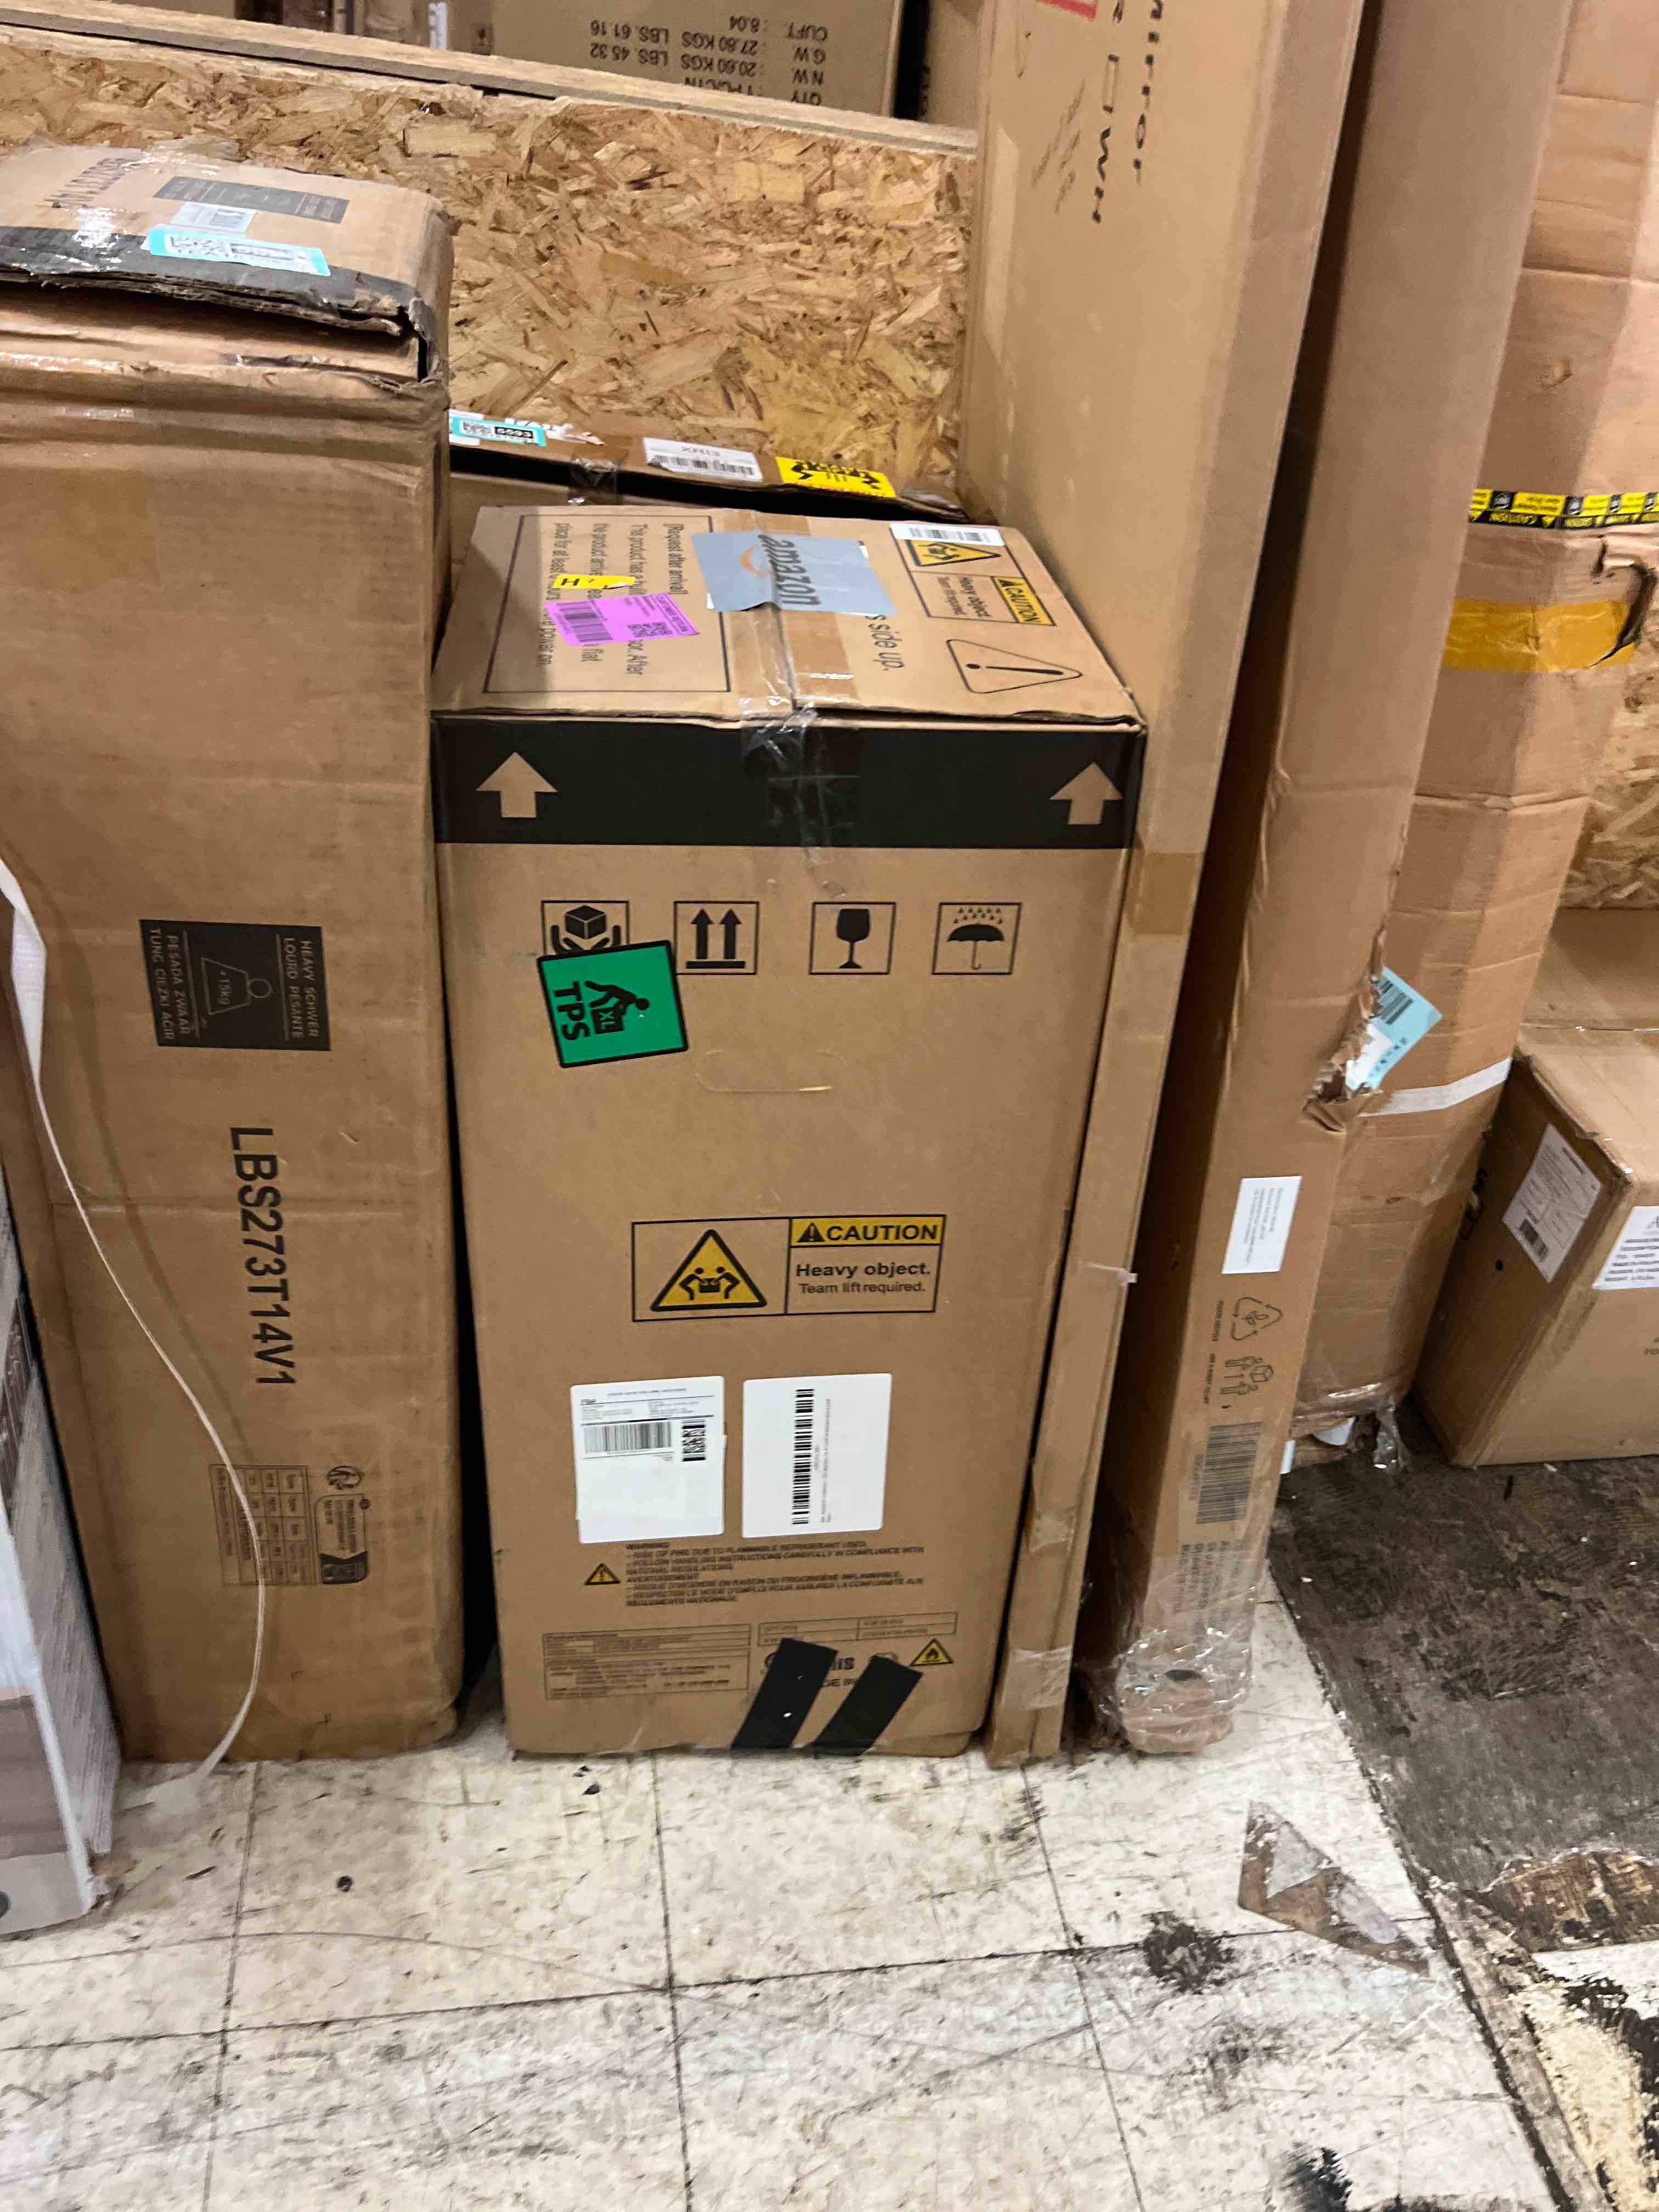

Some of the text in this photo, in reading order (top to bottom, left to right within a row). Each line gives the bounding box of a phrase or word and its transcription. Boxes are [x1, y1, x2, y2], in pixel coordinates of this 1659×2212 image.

[590, 20, 631, 40] 61.16
[729, 15, 760, 33] 8.04
[635, 26, 669, 44] LBS.
[681, 31, 715, 50] KGS
[635, 48, 668, 67] LBS.
[681, 53, 713, 71] KGS
[553, 523, 573, 539] place
[592, 523, 610, 533] the
[553, 540, 572, 549] for
[589, 533, 609, 557] product
[628, 537, 647, 560] product
[629, 561, 646, 575] has
[668, 553, 686, 568] after
[758, 534, 821, 606] amazon
[1004, 587, 1042, 623] CAUTION
[868, 624, 904, 648] side
[581, 648, 604, 662] flat
[873, 652, 905, 671] up.
[627, 656, 648, 675] After
[167, 935, 183, 985] PESADA
[283, 937, 304, 1038] LOURD PESANTE
[300, 940, 320, 1037] HEAVY SCHWER
[553, 980, 590, 1041] TPS
[599, 1011, 617, 1030] XL
[826, 1224, 938, 1241] CAUTION
[230, 1126, 296, 1385] LBS273T14V1
[795, 1262, 930, 1278] Heavy object.
[799, 1283, 838, 1294] Team
[862, 1281, 926, 1294] required.
